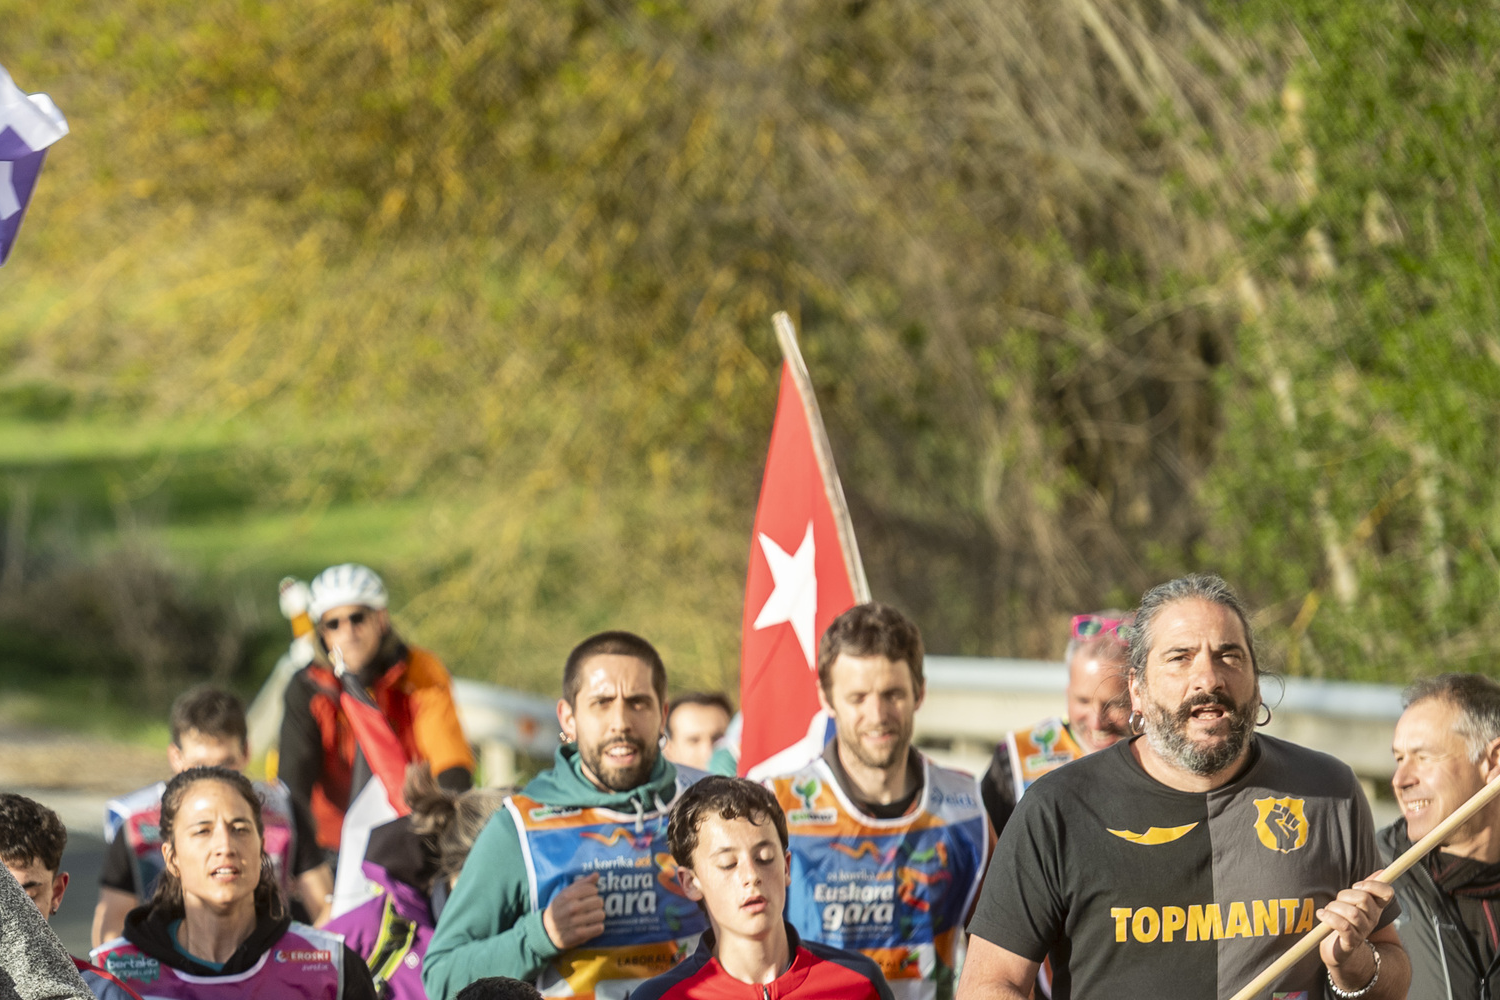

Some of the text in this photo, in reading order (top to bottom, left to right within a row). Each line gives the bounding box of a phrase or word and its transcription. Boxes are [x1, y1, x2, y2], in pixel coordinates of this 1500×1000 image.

[605, 890, 656, 917] ara
[814, 883, 894, 902] Euskara
[822, 902, 894, 931] gara
[1111, 898, 1314, 943] TOPMANTA
[290, 951, 330, 962] EROSKI
